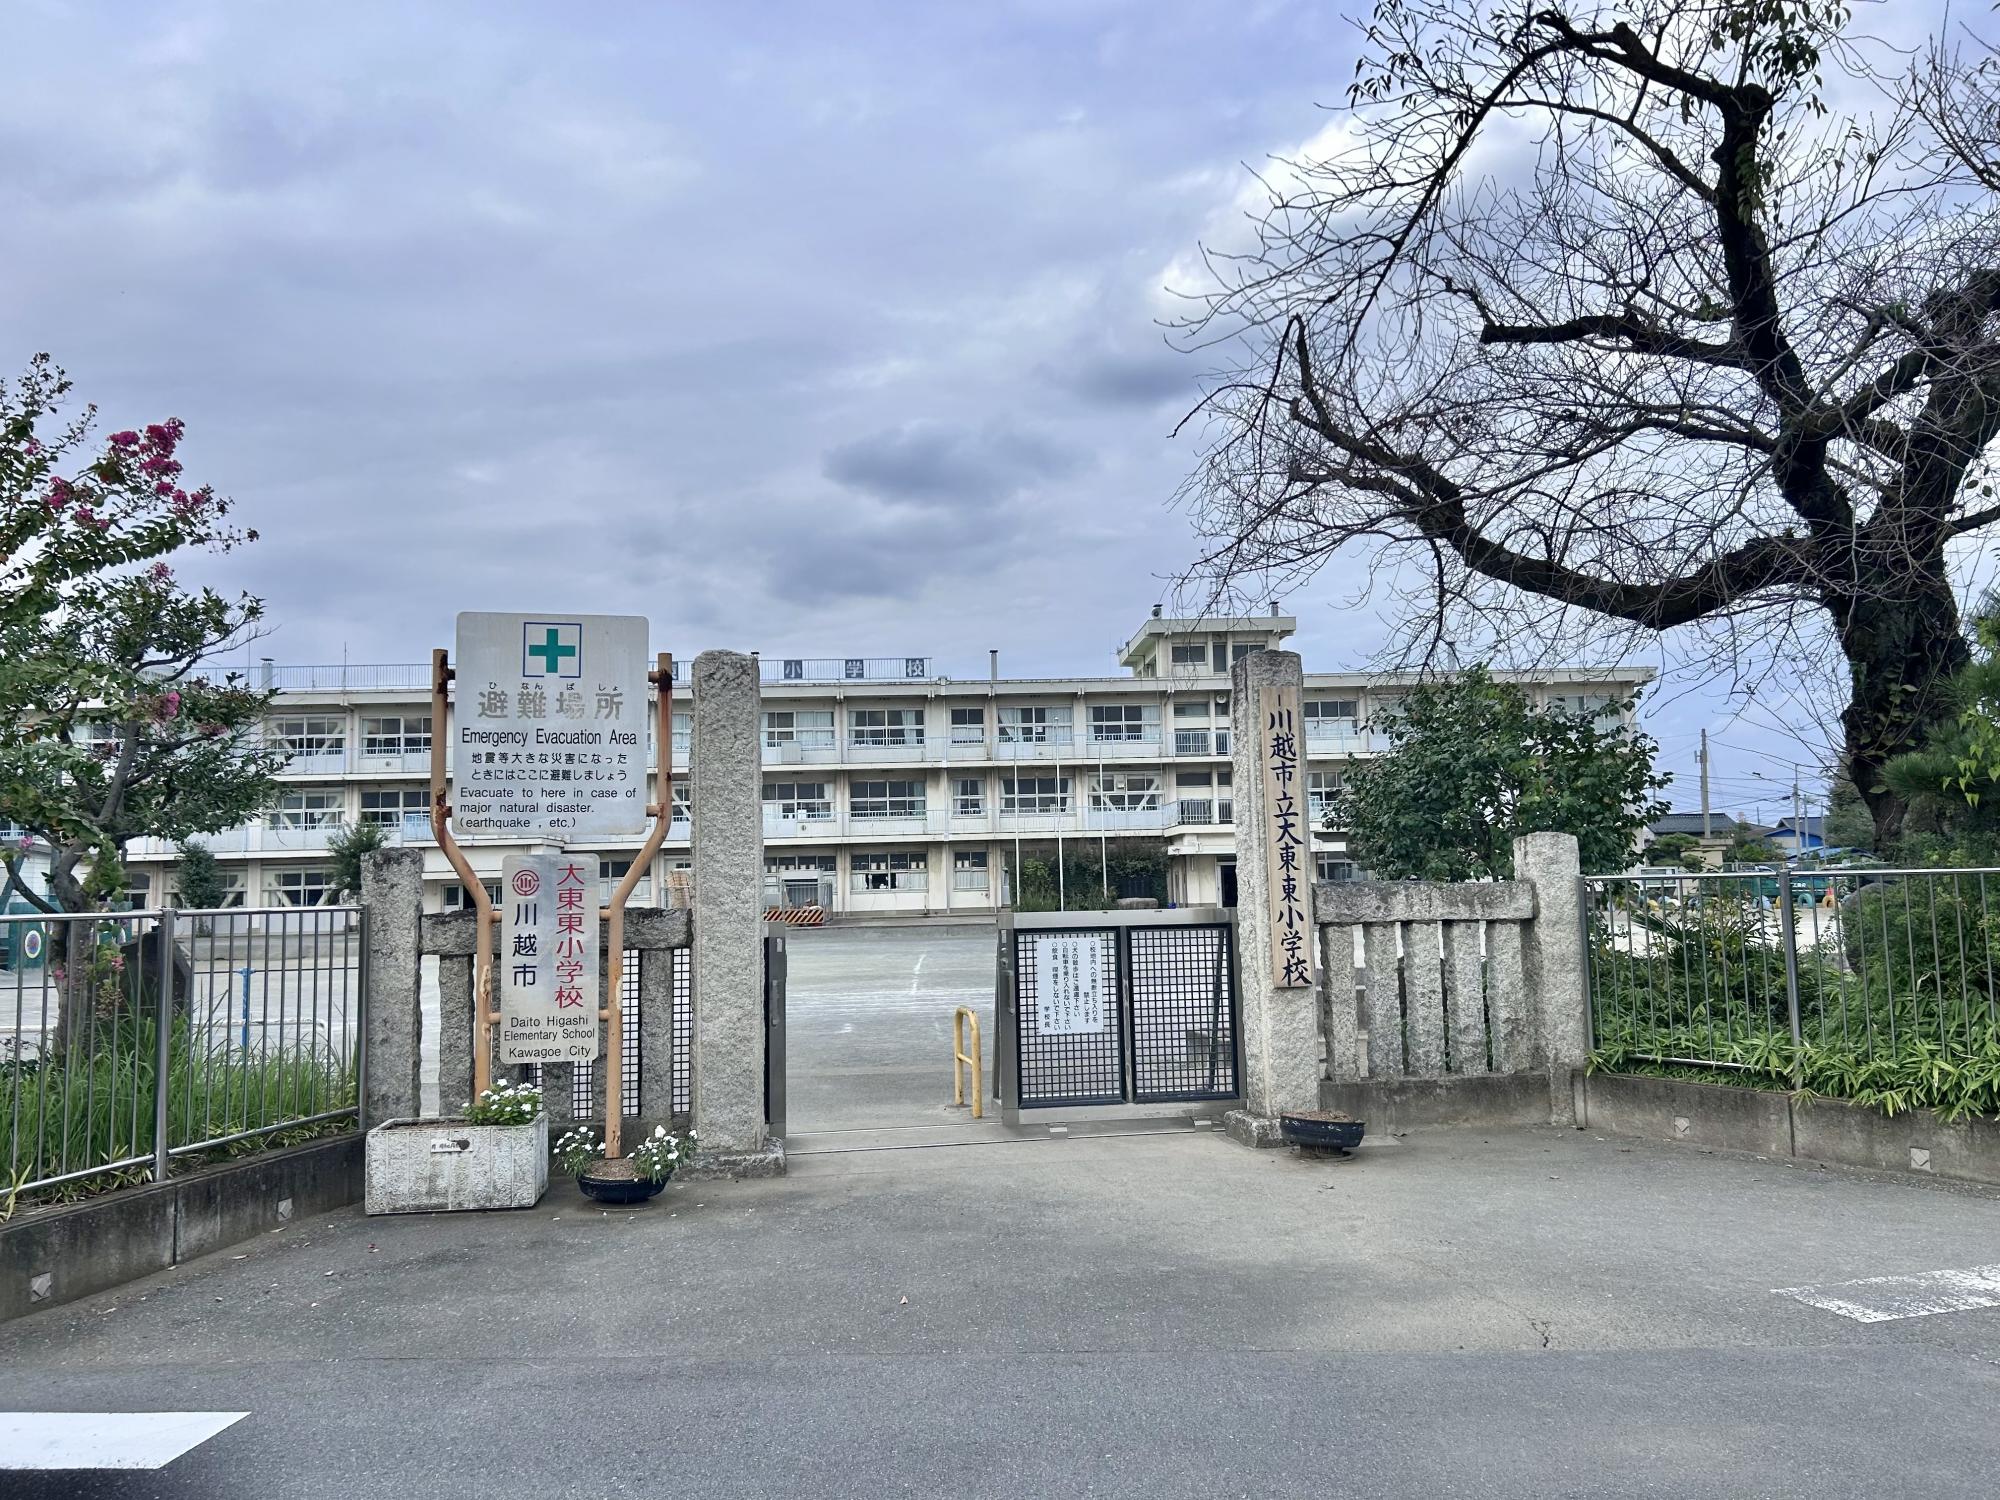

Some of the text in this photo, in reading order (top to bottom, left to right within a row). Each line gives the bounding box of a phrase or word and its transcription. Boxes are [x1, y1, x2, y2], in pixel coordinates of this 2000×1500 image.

[785, 659, 924, 678] 小学校
[477, 690, 624, 720] 避難場所
[462, 728, 637, 747] Emergency Evacuation Area
[471, 752, 628, 764] 地震等大きな災害になった
[471, 769, 627, 781] ときにはここに避難しましょう
[460, 787, 637, 798] Evacuate to here in case of
[460, 802, 594, 816] major natural disaster.
[1268, 708, 1312, 987] 川越市立大東東小学校
[555, 863, 585, 1009] 大東東小学校
[512, 903, 538, 987] 川越市
[510, 1014, 589, 1028] Daito Higashi
[504, 1027, 595, 1042] Elementary School
[509, 1045, 591, 1059] Kawagoe City
